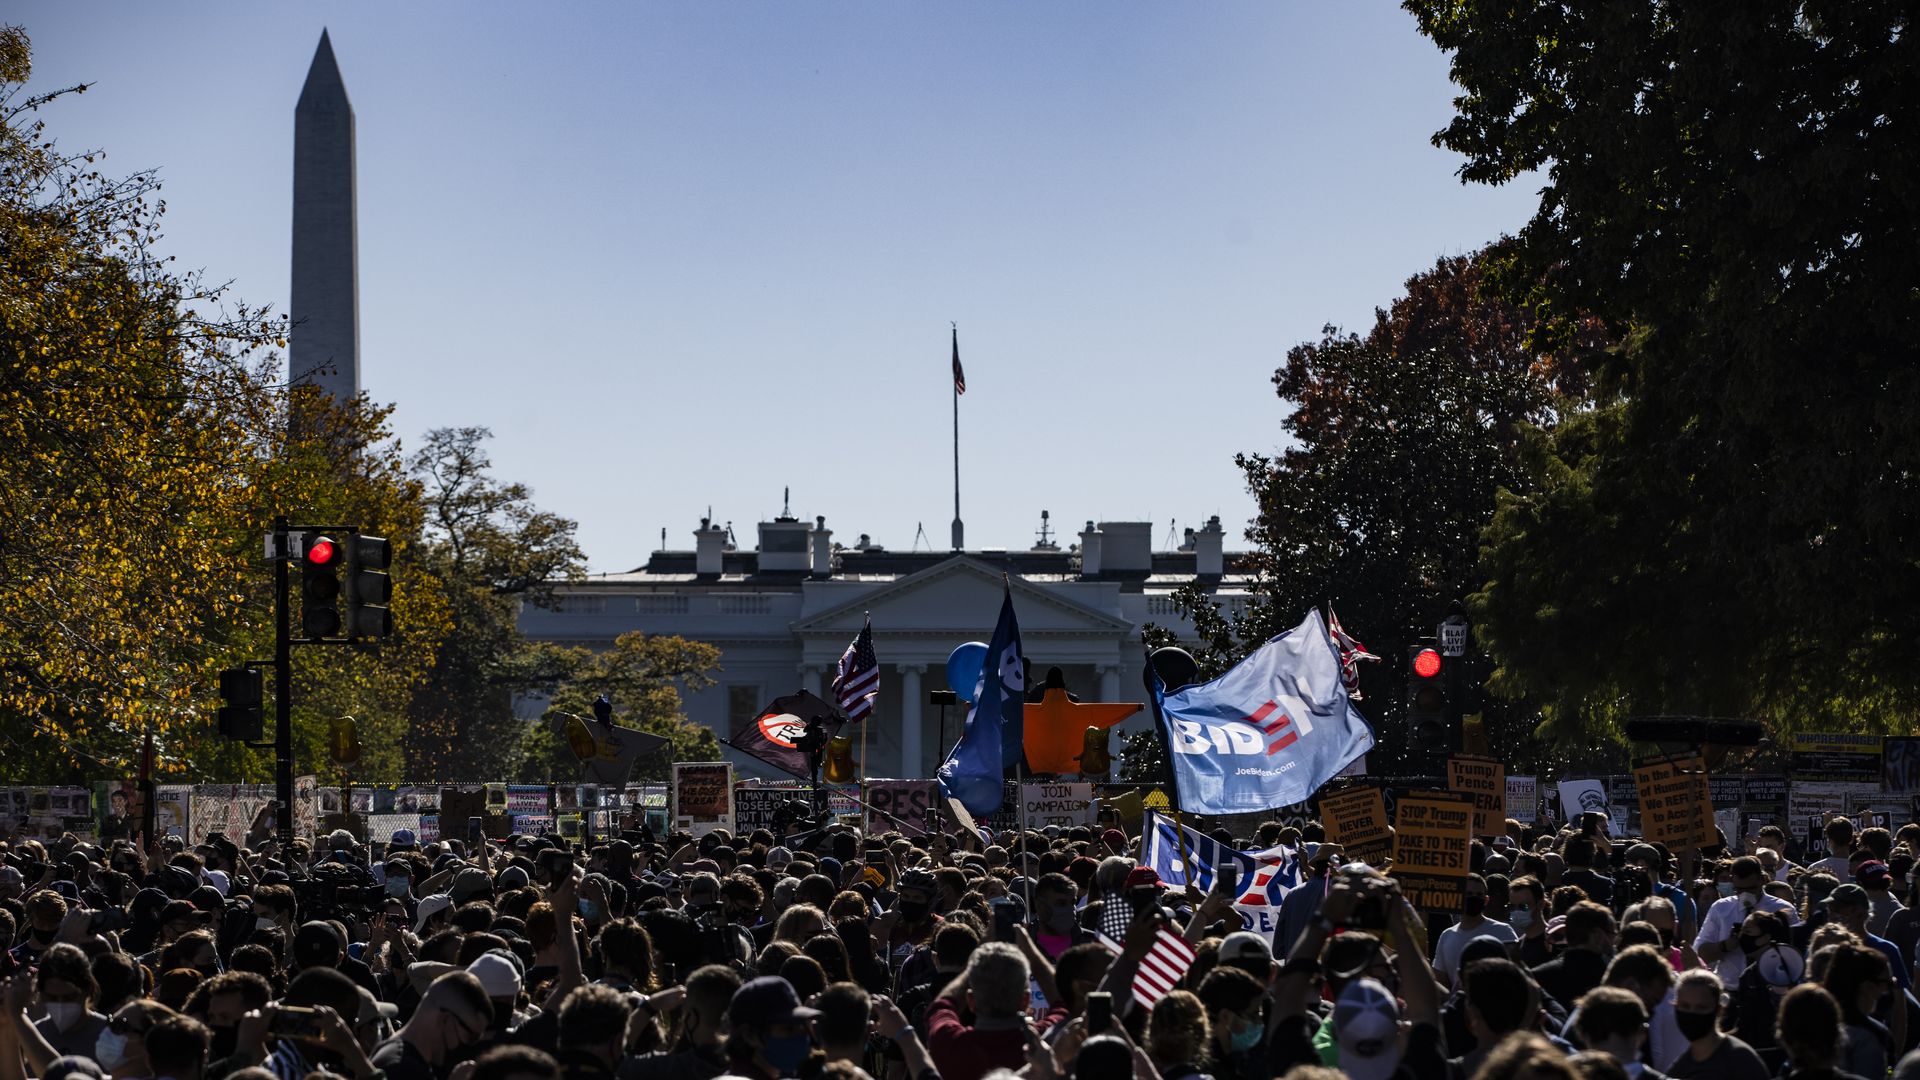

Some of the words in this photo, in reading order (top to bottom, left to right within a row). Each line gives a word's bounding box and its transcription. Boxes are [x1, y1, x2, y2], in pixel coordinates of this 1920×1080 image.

[1235, 761, 1296, 777] JoeBiden.com
[1452, 761, 1497, 777] Trump/
[1638, 774, 1649, 783] In
[1652, 769, 1670, 780] the
[1456, 776, 1495, 790] Pence
[1507, 785, 1535, 793] MATTER
[154, 792, 180, 801] USTICE
[745, 792, 764, 800] MAY
[768, 792, 786, 800] NOT
[790, 791, 815, 800] LIVE
[1041, 786, 1071, 798] JOIN
[1640, 786, 1651, 797] of
[737, 801, 750, 810] TO
[750, 801, 771, 810] SEE
[1322, 800, 1341, 809] White
[1362, 799, 1374, 807] and
[1475, 793, 1502, 812] ERA
[1646, 798, 1663, 810] We
[737, 811, 757, 822] BUT
[1401, 805, 1427, 818] STOP
[1430, 807, 1467, 823] Trump
[1653, 812, 1664, 822] to
[1043, 816, 1074, 828] ZERO
[1339, 816, 1374, 833] NEVER
[1333, 826, 1384, 846] Legitimate
[1656, 828, 1664, 836] a
[1398, 834, 1424, 848] TAKE
[1426, 836, 1439, 849] TO
[1441, 837, 1466, 851] THE
[1397, 849, 1463, 868] STREETS!
[1420, 890, 1464, 909] NOW!
